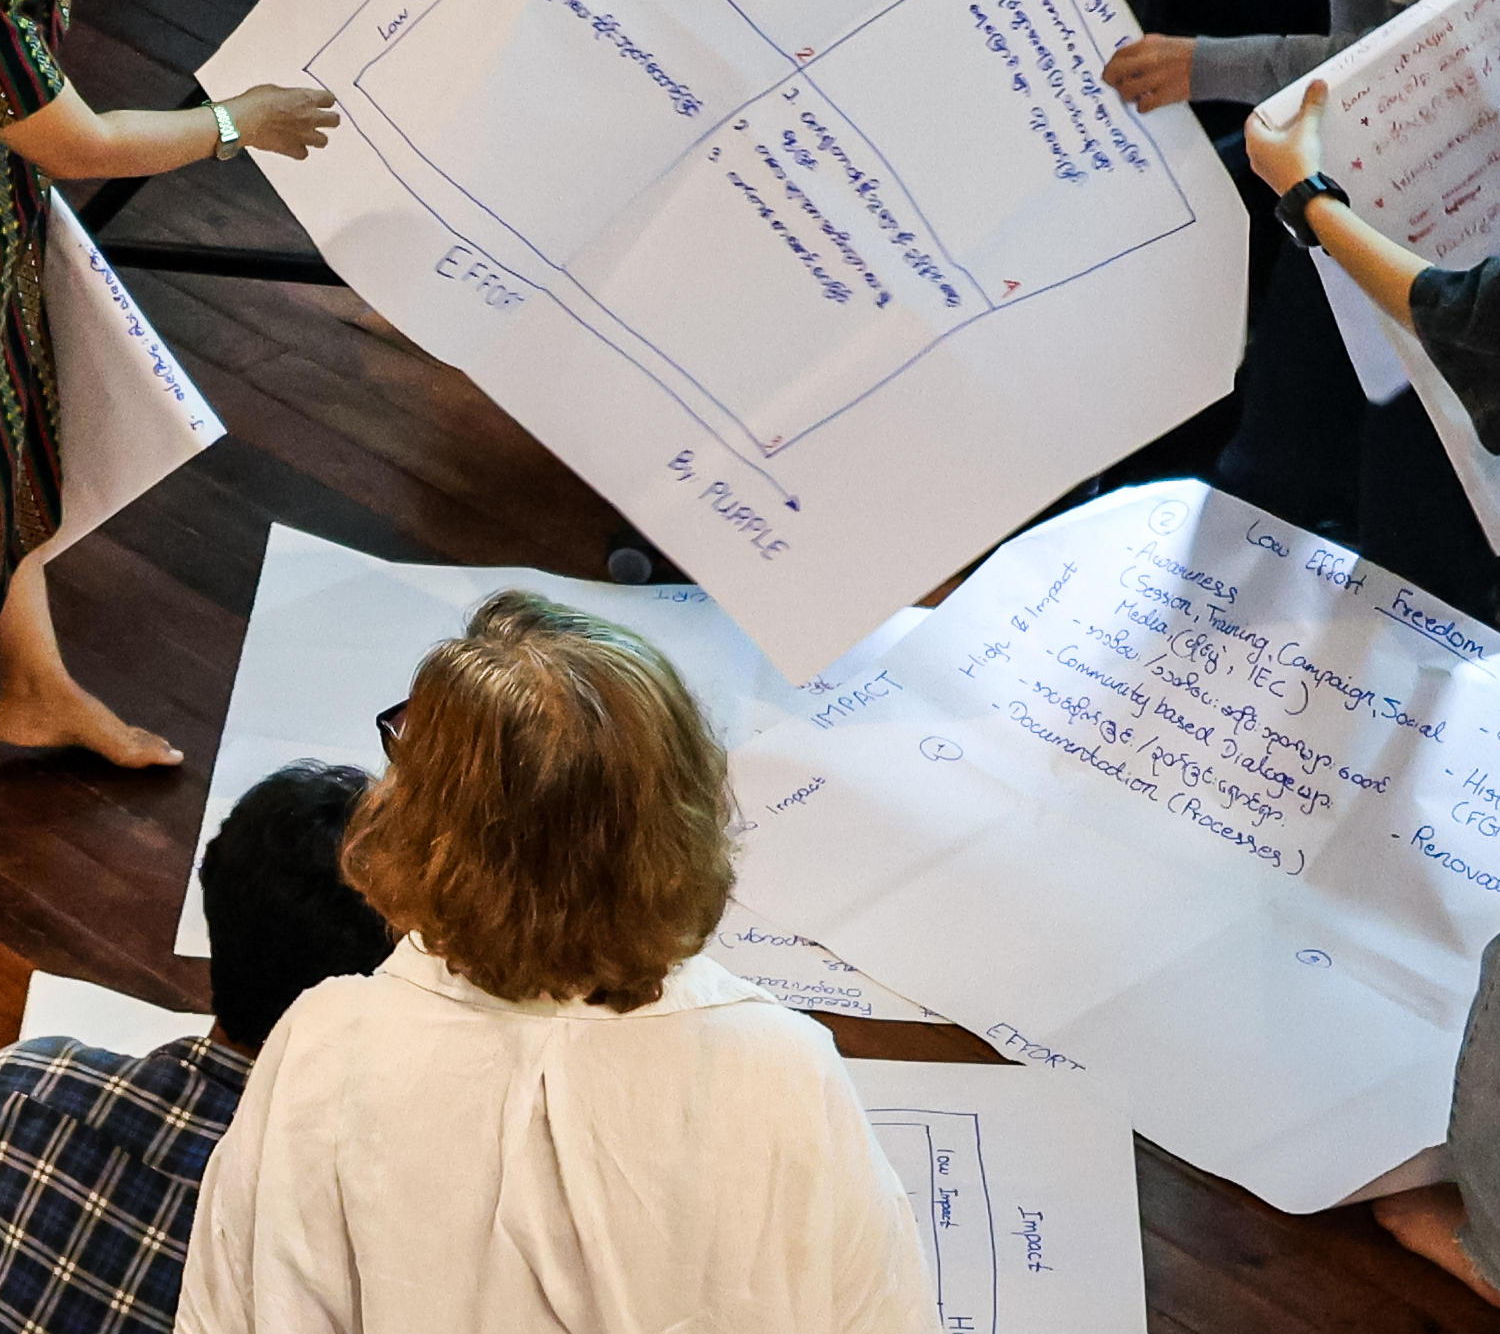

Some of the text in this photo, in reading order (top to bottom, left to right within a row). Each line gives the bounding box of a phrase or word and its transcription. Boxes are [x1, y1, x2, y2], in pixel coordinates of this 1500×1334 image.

[376, 8, 409, 43] Low
[697, 480, 791, 561] PURPLE
[1023, 560, 1078, 619] Impact
[1136, 547, 1240, 606] Awareness
[1244, 519, 1291, 559] Low
[1384, 587, 1500, 664] Freedom
[809, 668, 905, 731] IMPACT
[1056, 645, 1216, 748] Community based
[1008, 700, 1160, 803] Documentation
[1011, 1205, 1054, 1274] Impact
